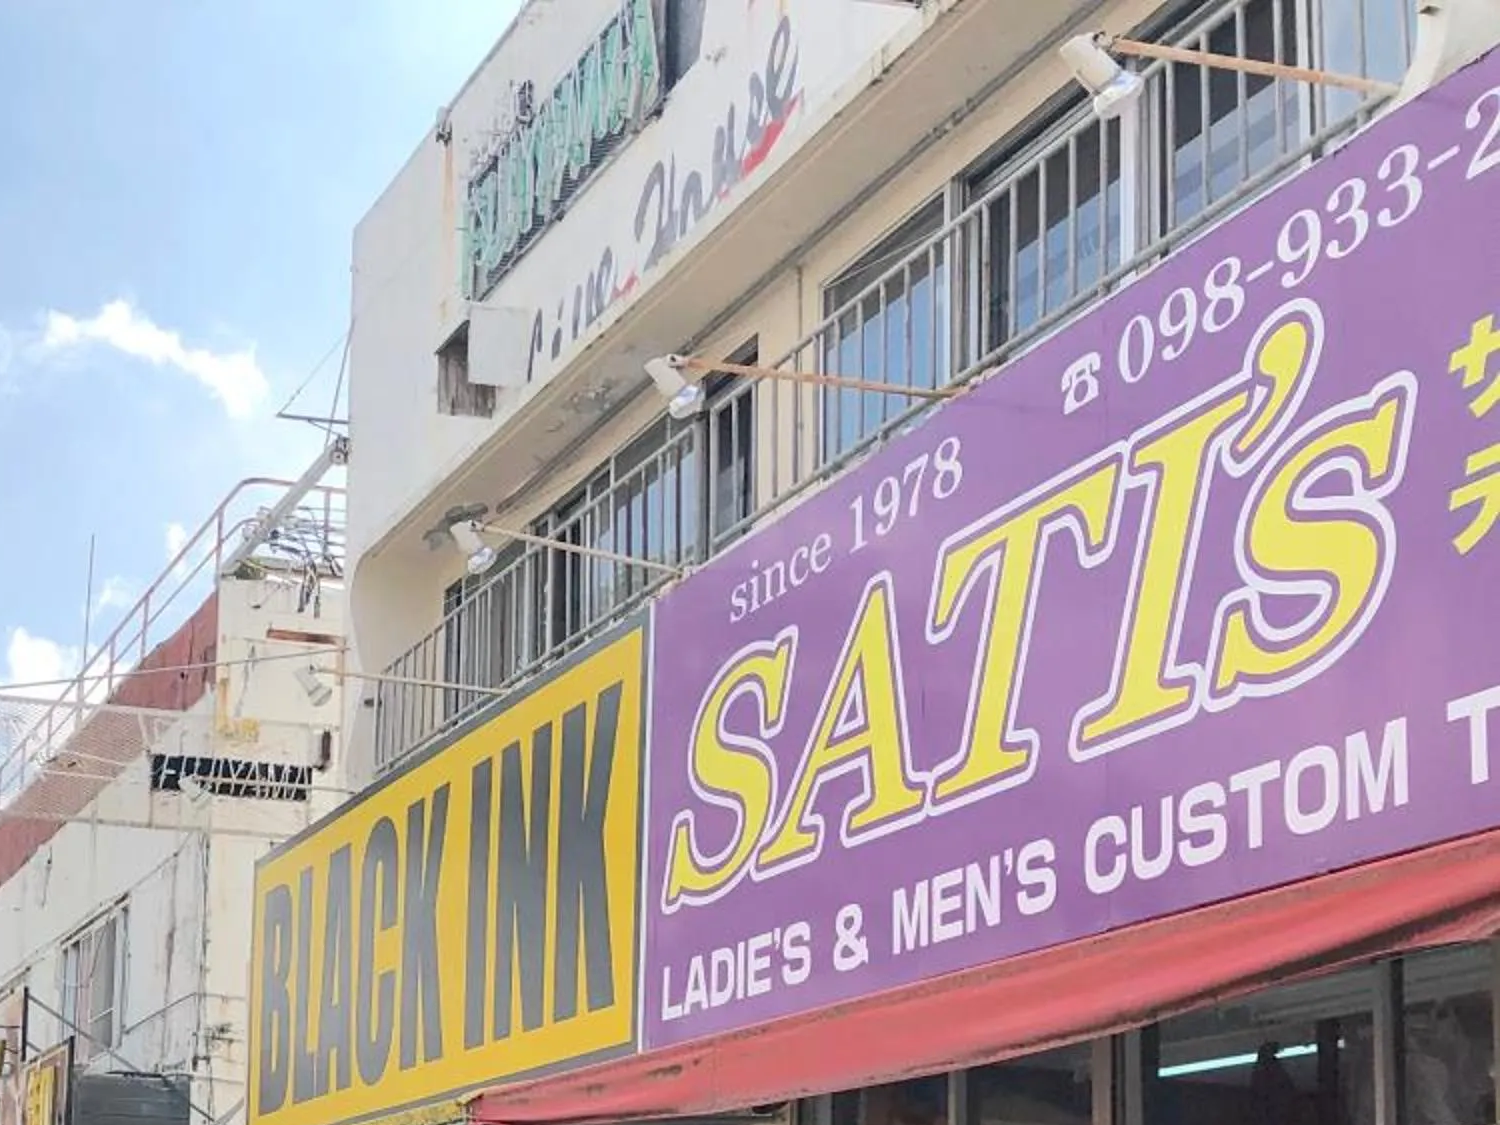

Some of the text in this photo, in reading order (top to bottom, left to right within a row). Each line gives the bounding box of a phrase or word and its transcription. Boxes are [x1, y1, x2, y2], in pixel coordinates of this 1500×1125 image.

[729, 436, 964, 622] since 1978
[257, 680, 623, 1118] BLACK INK
[661, 922, 812, 1022] LADIE'S
[832, 904, 870, 970] &
[891, 844, 1058, 953] MEN'S
[1084, 717, 1410, 894] CUSTOM
